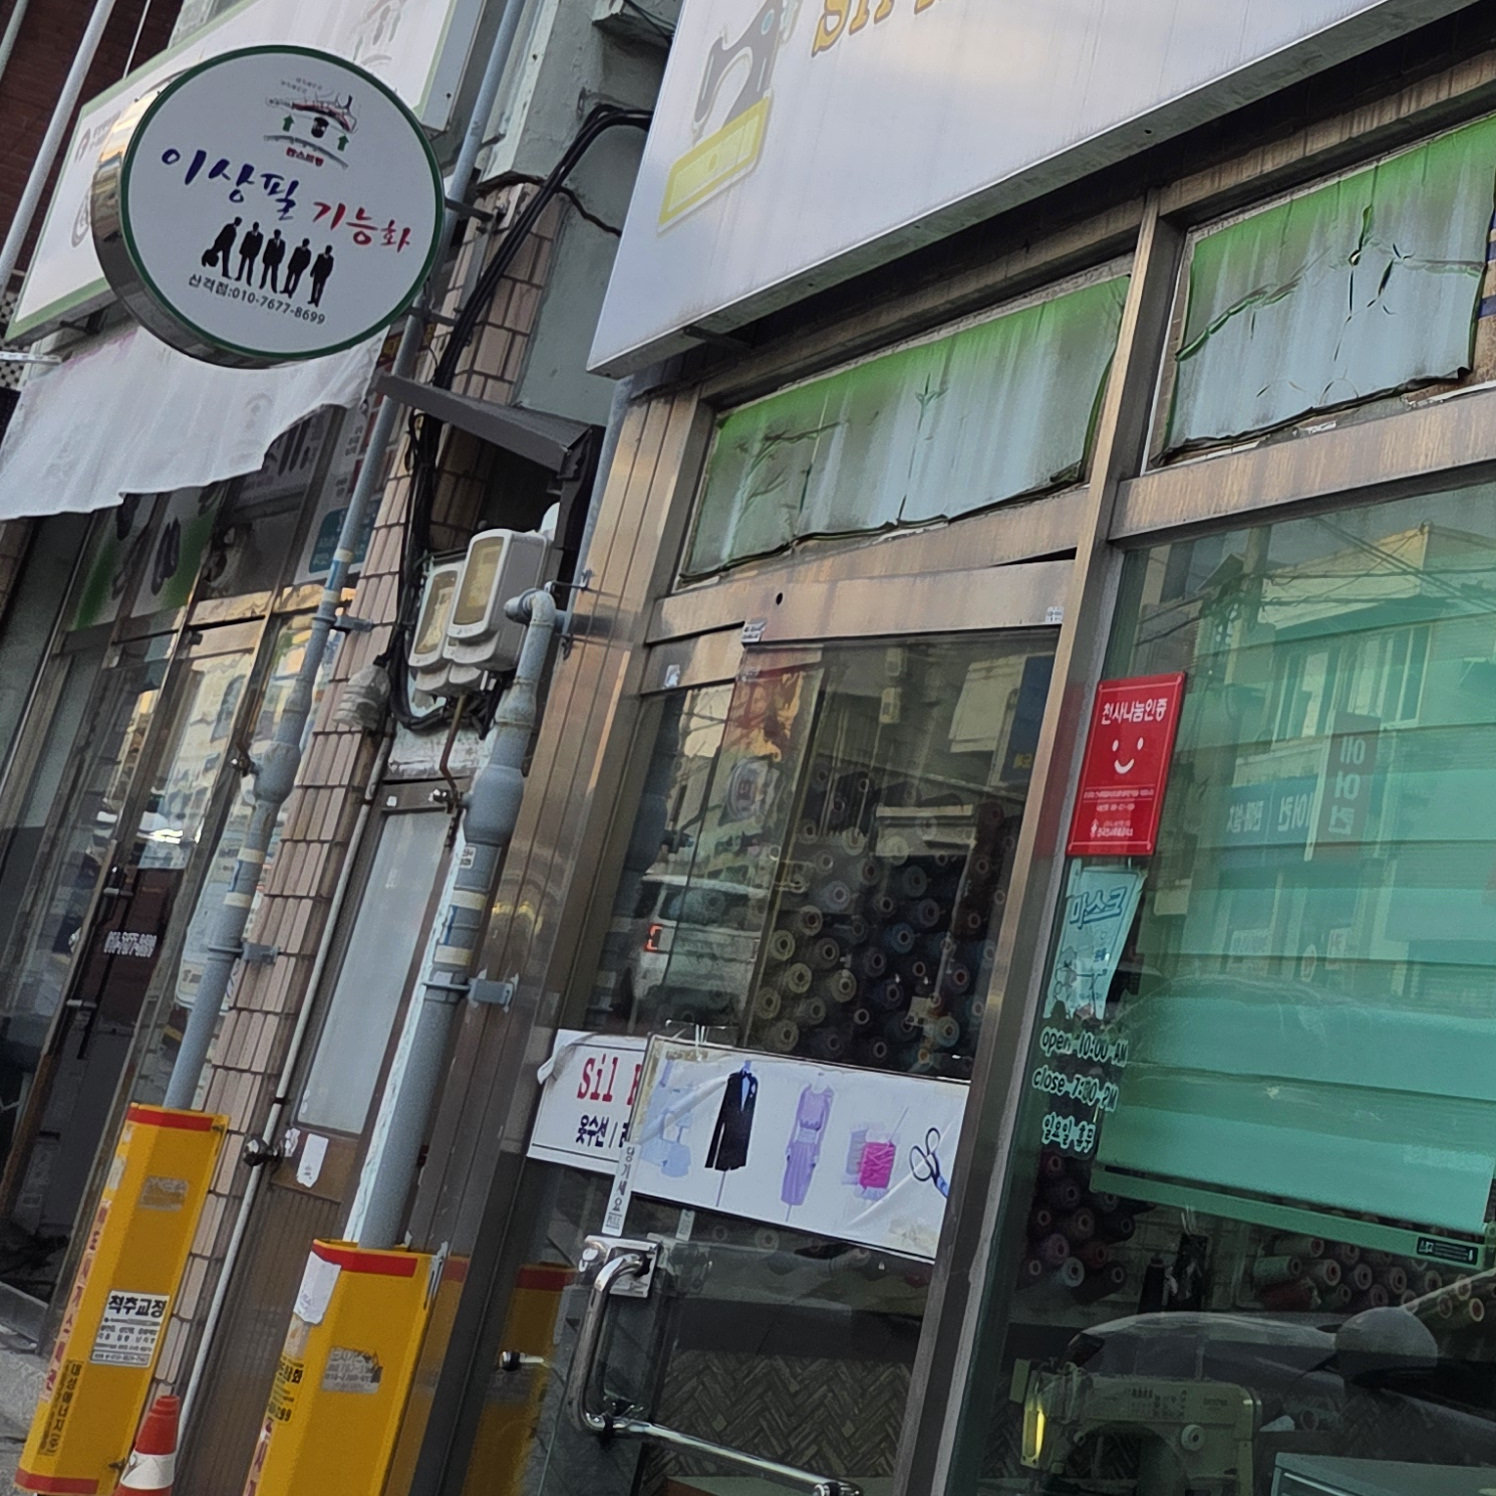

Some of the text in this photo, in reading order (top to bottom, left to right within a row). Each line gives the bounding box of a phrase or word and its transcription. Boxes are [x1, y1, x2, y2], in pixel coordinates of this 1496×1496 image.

[161, 148, 411, 253] 이상필 기능화
[1101, 698, 1168, 725] 천사나눔인증
[1041, 1028, 1073, 1055] open
[577, 1053, 618, 1102] Sil
[1033, 1066, 1066, 1094] close
[1042, 1113, 1074, 1149] 일요일
[611, 1146, 635, 1212] 당기세요
[108, 1295, 167, 1318] 척추교정
